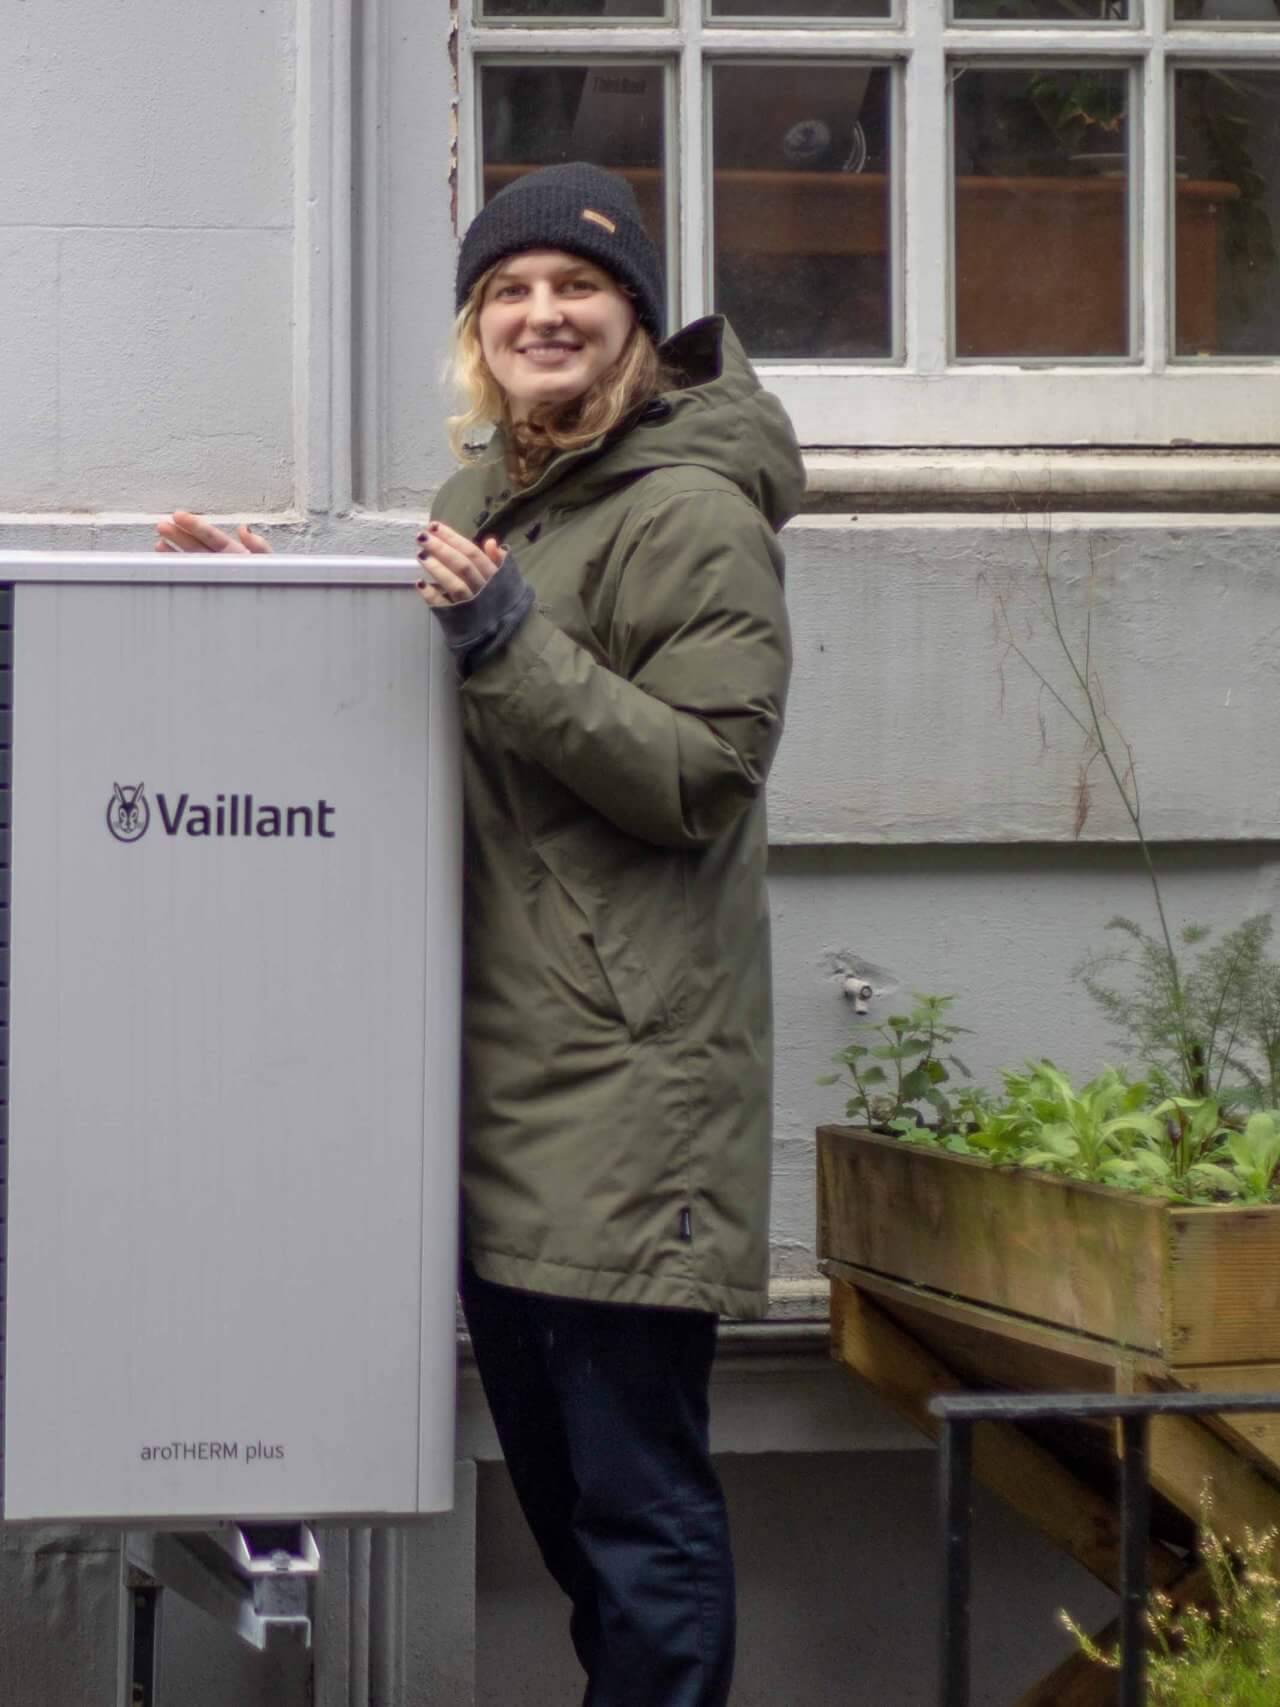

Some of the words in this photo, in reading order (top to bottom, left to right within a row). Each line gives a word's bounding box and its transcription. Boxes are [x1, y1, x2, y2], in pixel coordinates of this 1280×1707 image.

[155, 793, 336, 838] Vaillant
[140, 1441, 238, 1461] aroTHERM
[245, 1440, 285, 1464] plus
